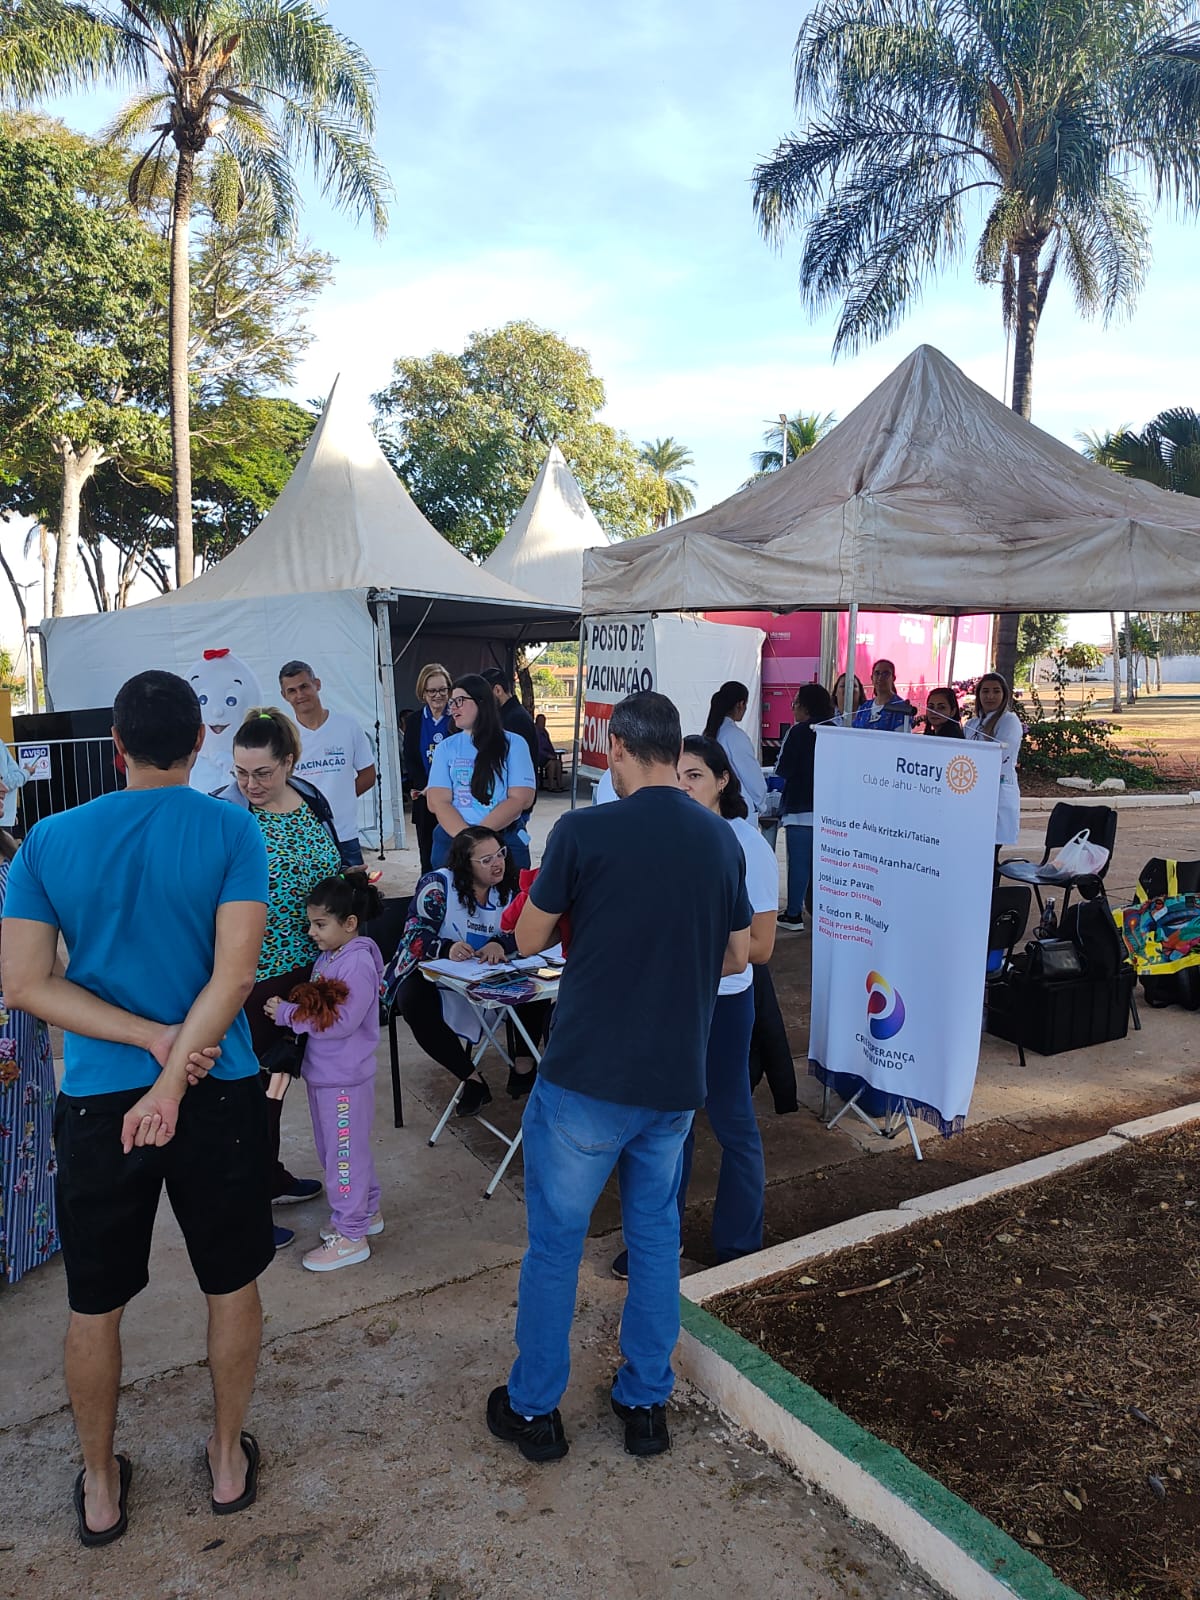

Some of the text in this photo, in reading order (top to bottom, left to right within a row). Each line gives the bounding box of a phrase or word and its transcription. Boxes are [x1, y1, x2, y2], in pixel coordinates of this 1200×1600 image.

[592, 624, 646, 651] POSTO DE
[23, 749, 46, 757] AVISO
[896, 757, 943, 782] Rotary
[863, 774, 878, 786] Club
[879, 776, 889, 788] de
[892, 780, 912, 791] Jahu
[919, 783, 942, 795] Norte
[849, 820, 861, 830] de
[878, 826, 940, 846] Kritzki/Tatiane
[879, 856, 940, 878] Aranha/Carina
[855, 911, 863, 921] R.
[337, 1096, 351, 1193] FAVORITE APPS
